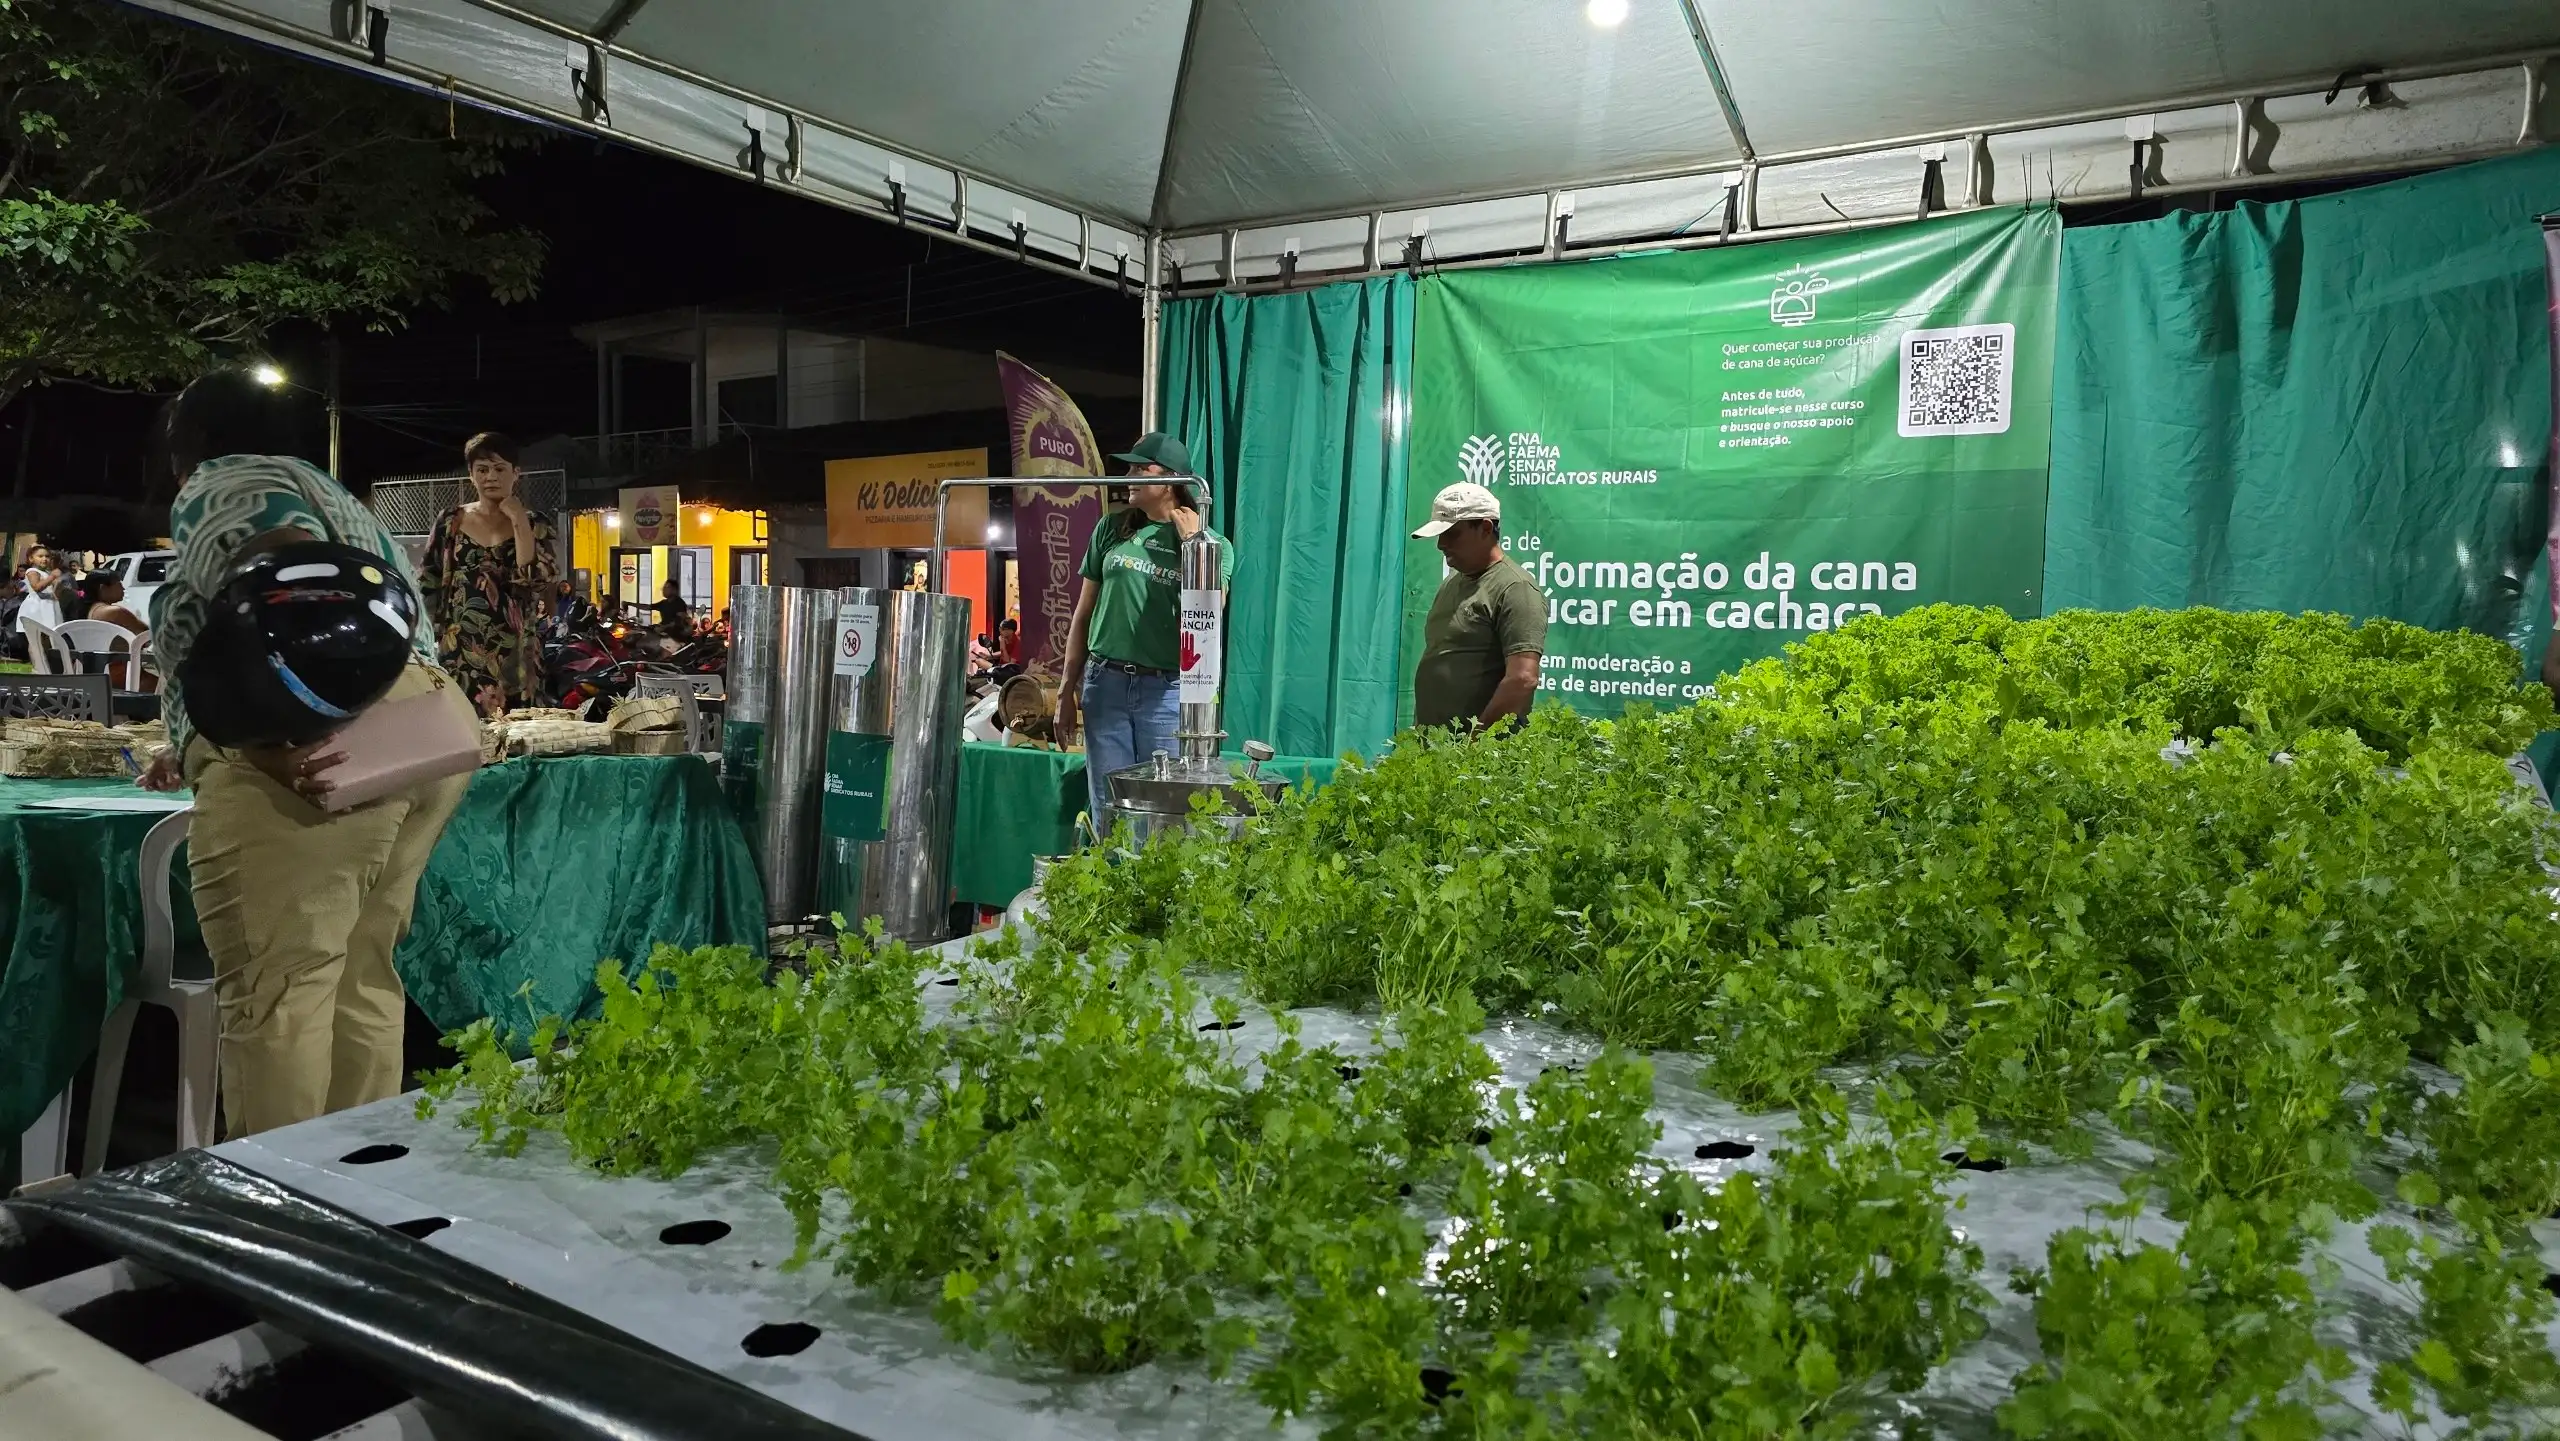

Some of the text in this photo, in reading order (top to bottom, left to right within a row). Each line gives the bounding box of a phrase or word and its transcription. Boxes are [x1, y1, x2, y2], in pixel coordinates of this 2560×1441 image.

[1722, 334, 1881, 355] Quer começar sua produção
[1722, 354, 1825, 370] de cana de açúcar?
[1721, 387, 1805, 402] Antes de tudo,
[1721, 400, 1865, 418] matricule-se nesse curso
[1720, 415, 1854, 433] e busque o nosso apoio
[1040, 436, 1075, 457] PURO
[1508, 432, 1541, 446] CNA
[1718, 434, 1791, 448] e orientação.
[1508, 445, 1560, 459] FAEMA
[1508, 459, 1557, 473] SENAR
[1508, 469, 1657, 487] SINDICATOS RURAIS
[857, 478, 951, 511] Ki Delici
[1517, 530, 1541, 551] de
[1743, 551, 1795, 591] da
[1810, 561, 1917, 591] cana
[1182, 610, 1215, 620] TENHA
[1629, 599, 1692, 627] em
[1571, 653, 1675, 677] moderação
[1680, 660, 1691, 674] a
[1561, 673, 1585, 692] de
[1589, 677, 1677, 697] aprender
[854, 790, 873, 798] RURAIS
